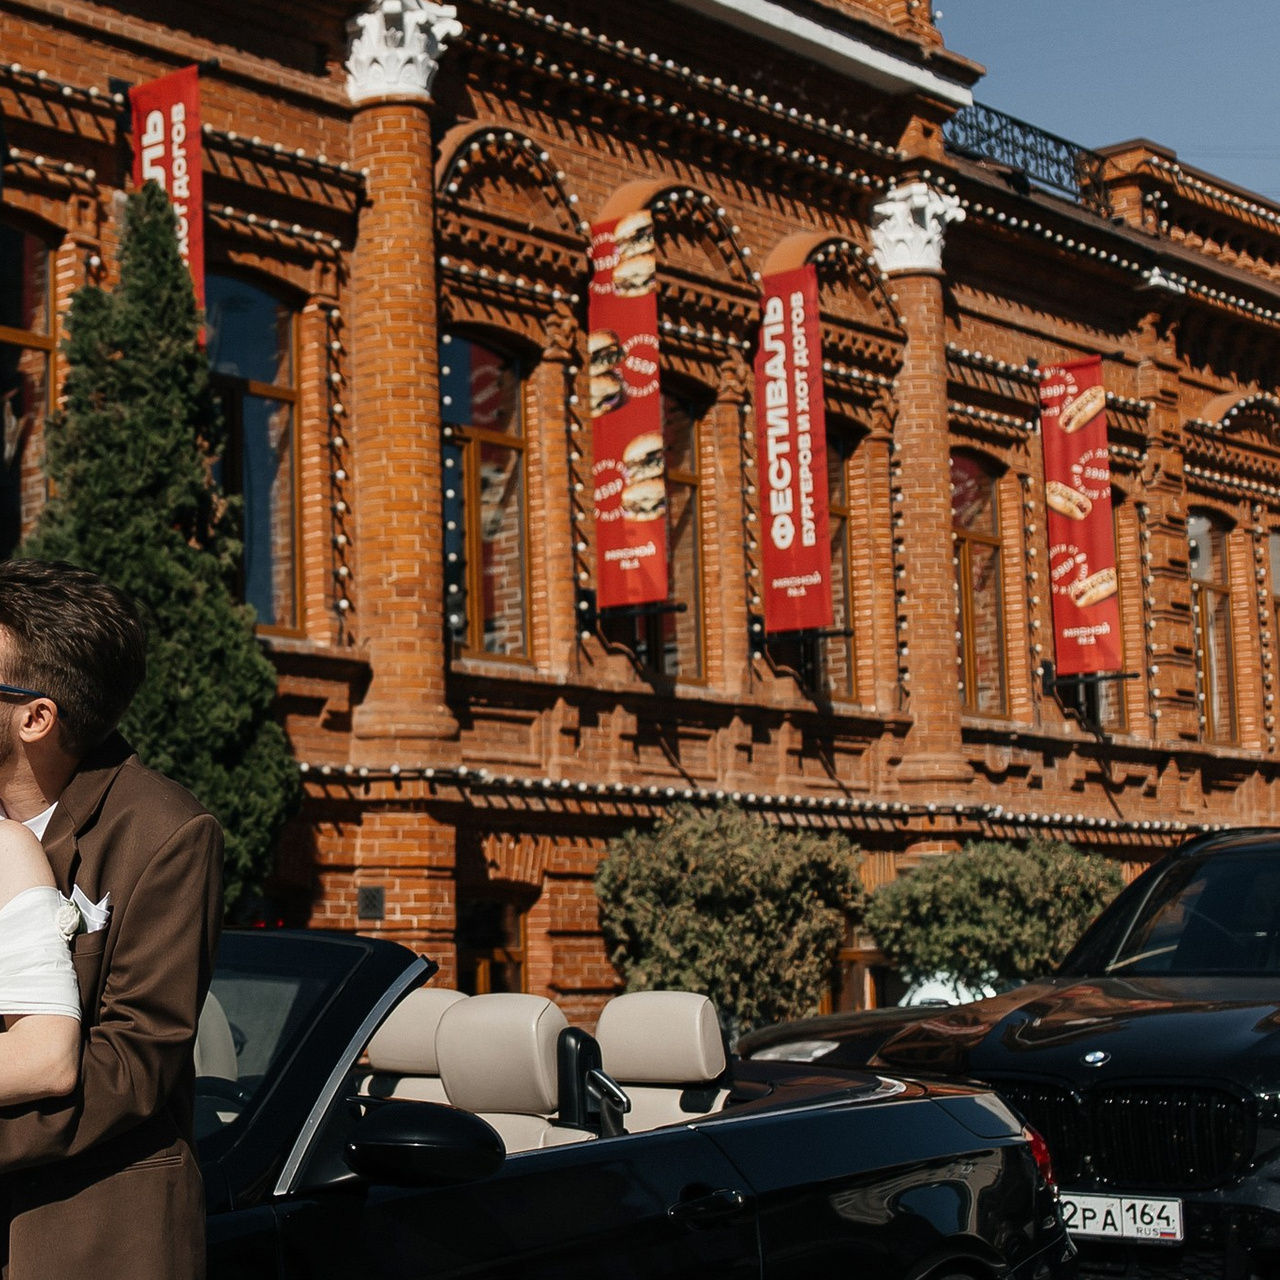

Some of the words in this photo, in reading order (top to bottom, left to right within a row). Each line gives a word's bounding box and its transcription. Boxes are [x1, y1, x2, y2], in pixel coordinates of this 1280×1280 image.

[170, 101, 191, 200] ДОГОВ
[790, 290, 809, 368] ДОГОВ
[793, 369, 810, 413] ХОТ
[763, 296, 796, 551] ФЕСТИВАЛЬ
[797, 415, 810, 431] И
[797, 432, 817, 548] БУРГЕРОВ
[1125, 1202, 1170, 1227] 164
[1136, 1226, 1159, 1237] RUS
